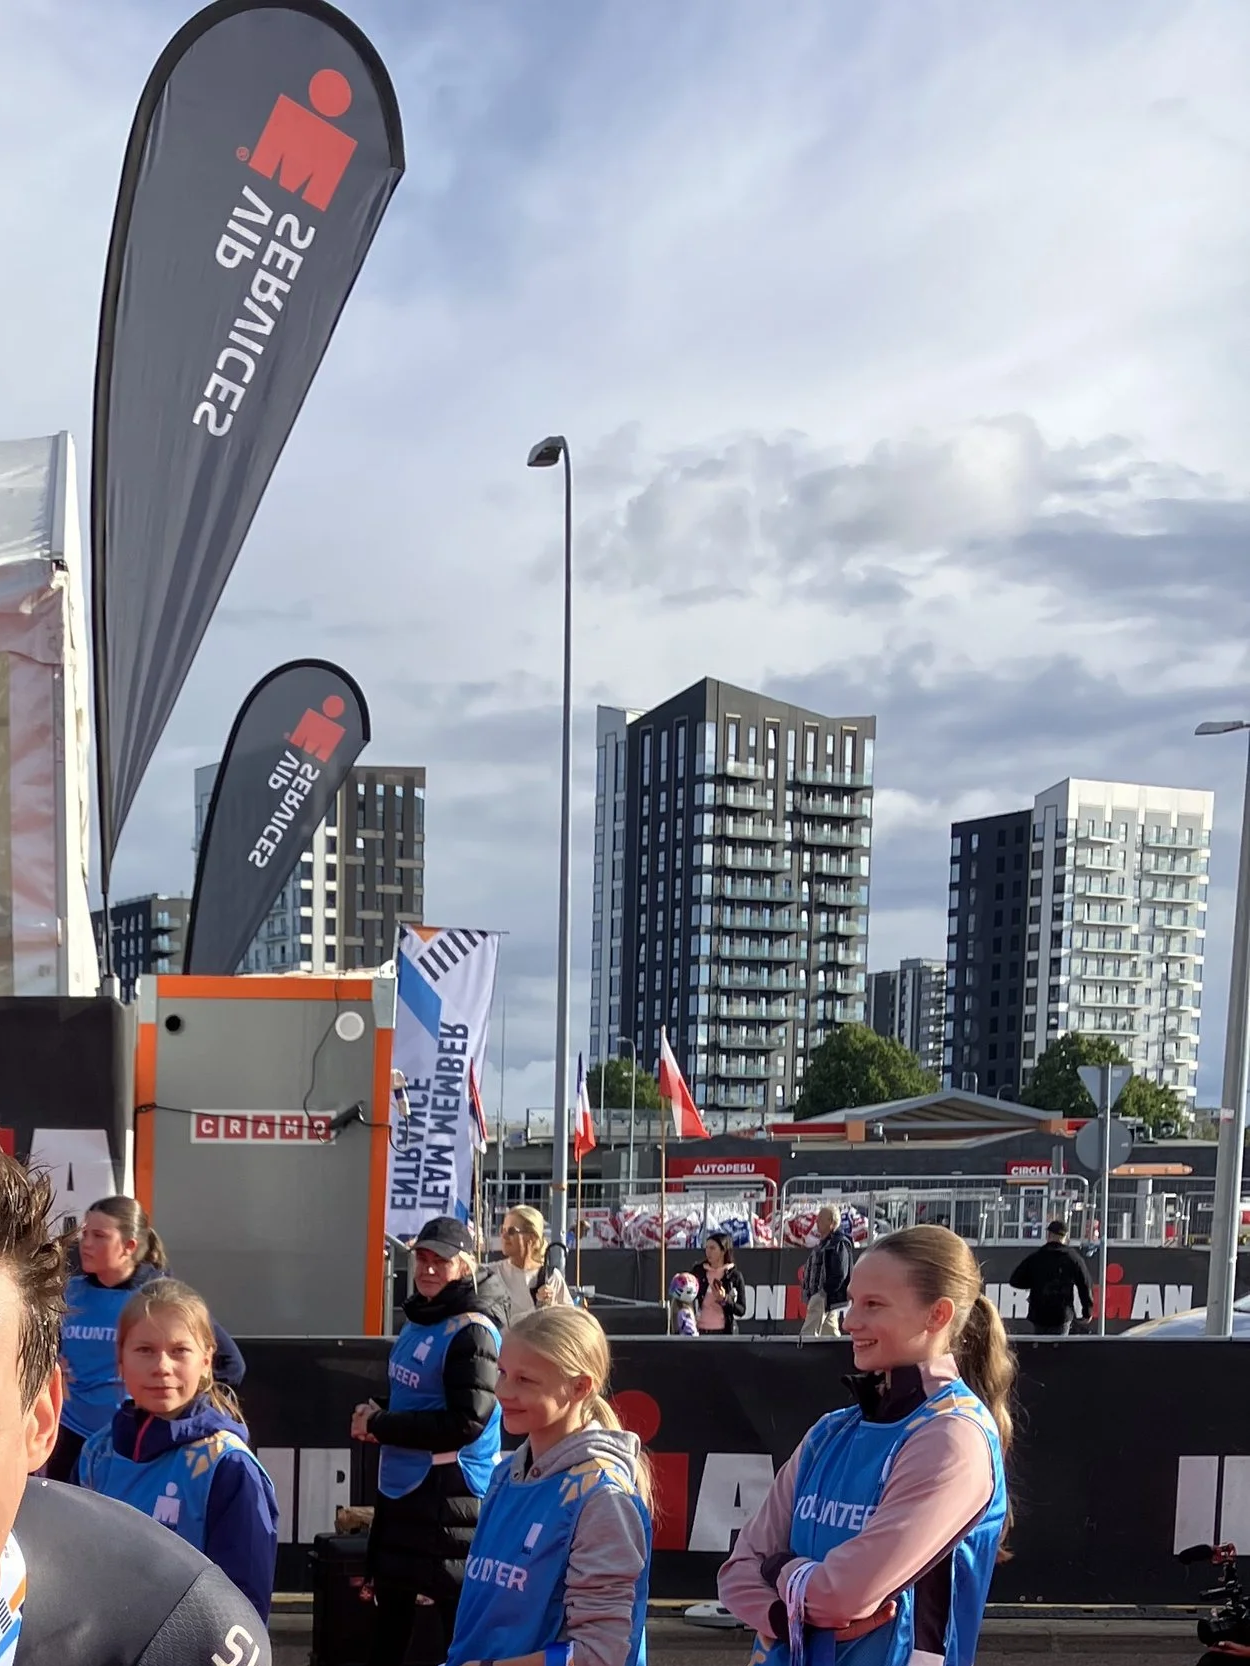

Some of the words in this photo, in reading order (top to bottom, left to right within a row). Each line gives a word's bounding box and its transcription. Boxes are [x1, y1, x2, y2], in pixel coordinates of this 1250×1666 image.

[200, 1118, 327, 1136] CRAMO
[693, 1163, 756, 1175] AUTOPESU
[1011, 1166, 1048, 1176] CIRCLE
